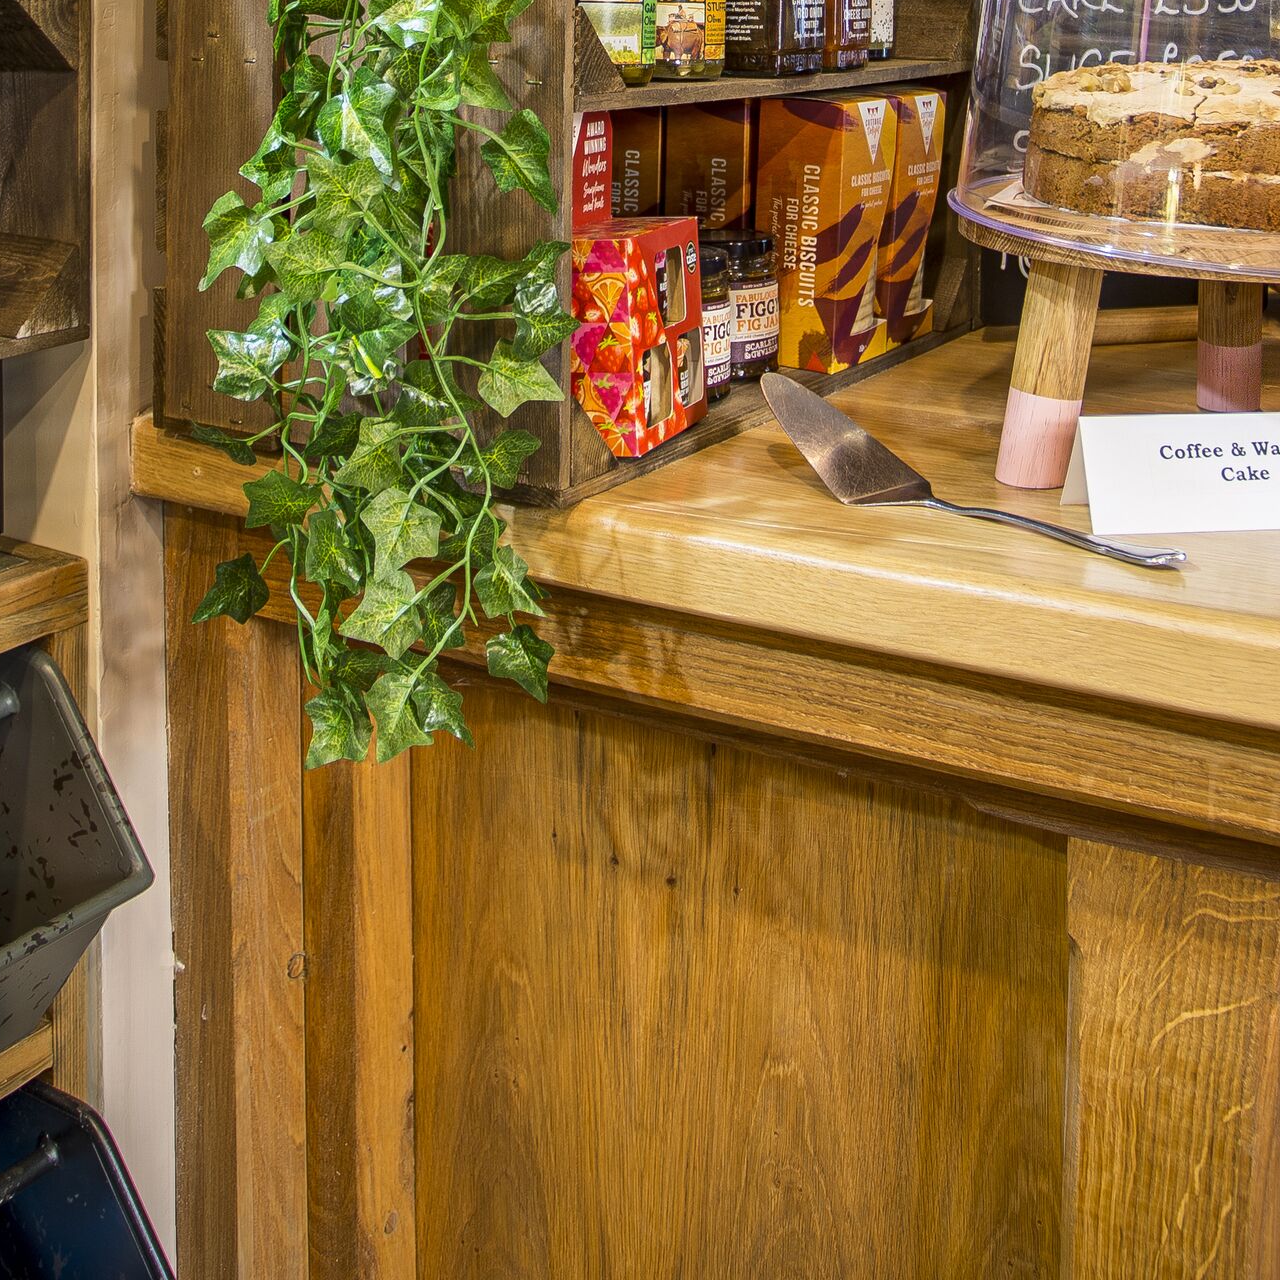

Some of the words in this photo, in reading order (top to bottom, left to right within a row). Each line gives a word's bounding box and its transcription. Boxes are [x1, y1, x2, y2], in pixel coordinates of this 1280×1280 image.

[624, 149, 640, 213] CLASSIC
[710, 157, 726, 222] CLASSIC
[801, 164, 821, 230] CLASSIC
[786, 198, 800, 221] FOR
[783, 224, 798, 271] CHEESE
[798, 236, 817, 308] BISCUITS
[737, 319, 761, 333] FIG
[1159, 442, 1223, 460] Coffee
[1231, 440, 1246, 457] &
[1220, 465, 1270, 482] Cake
